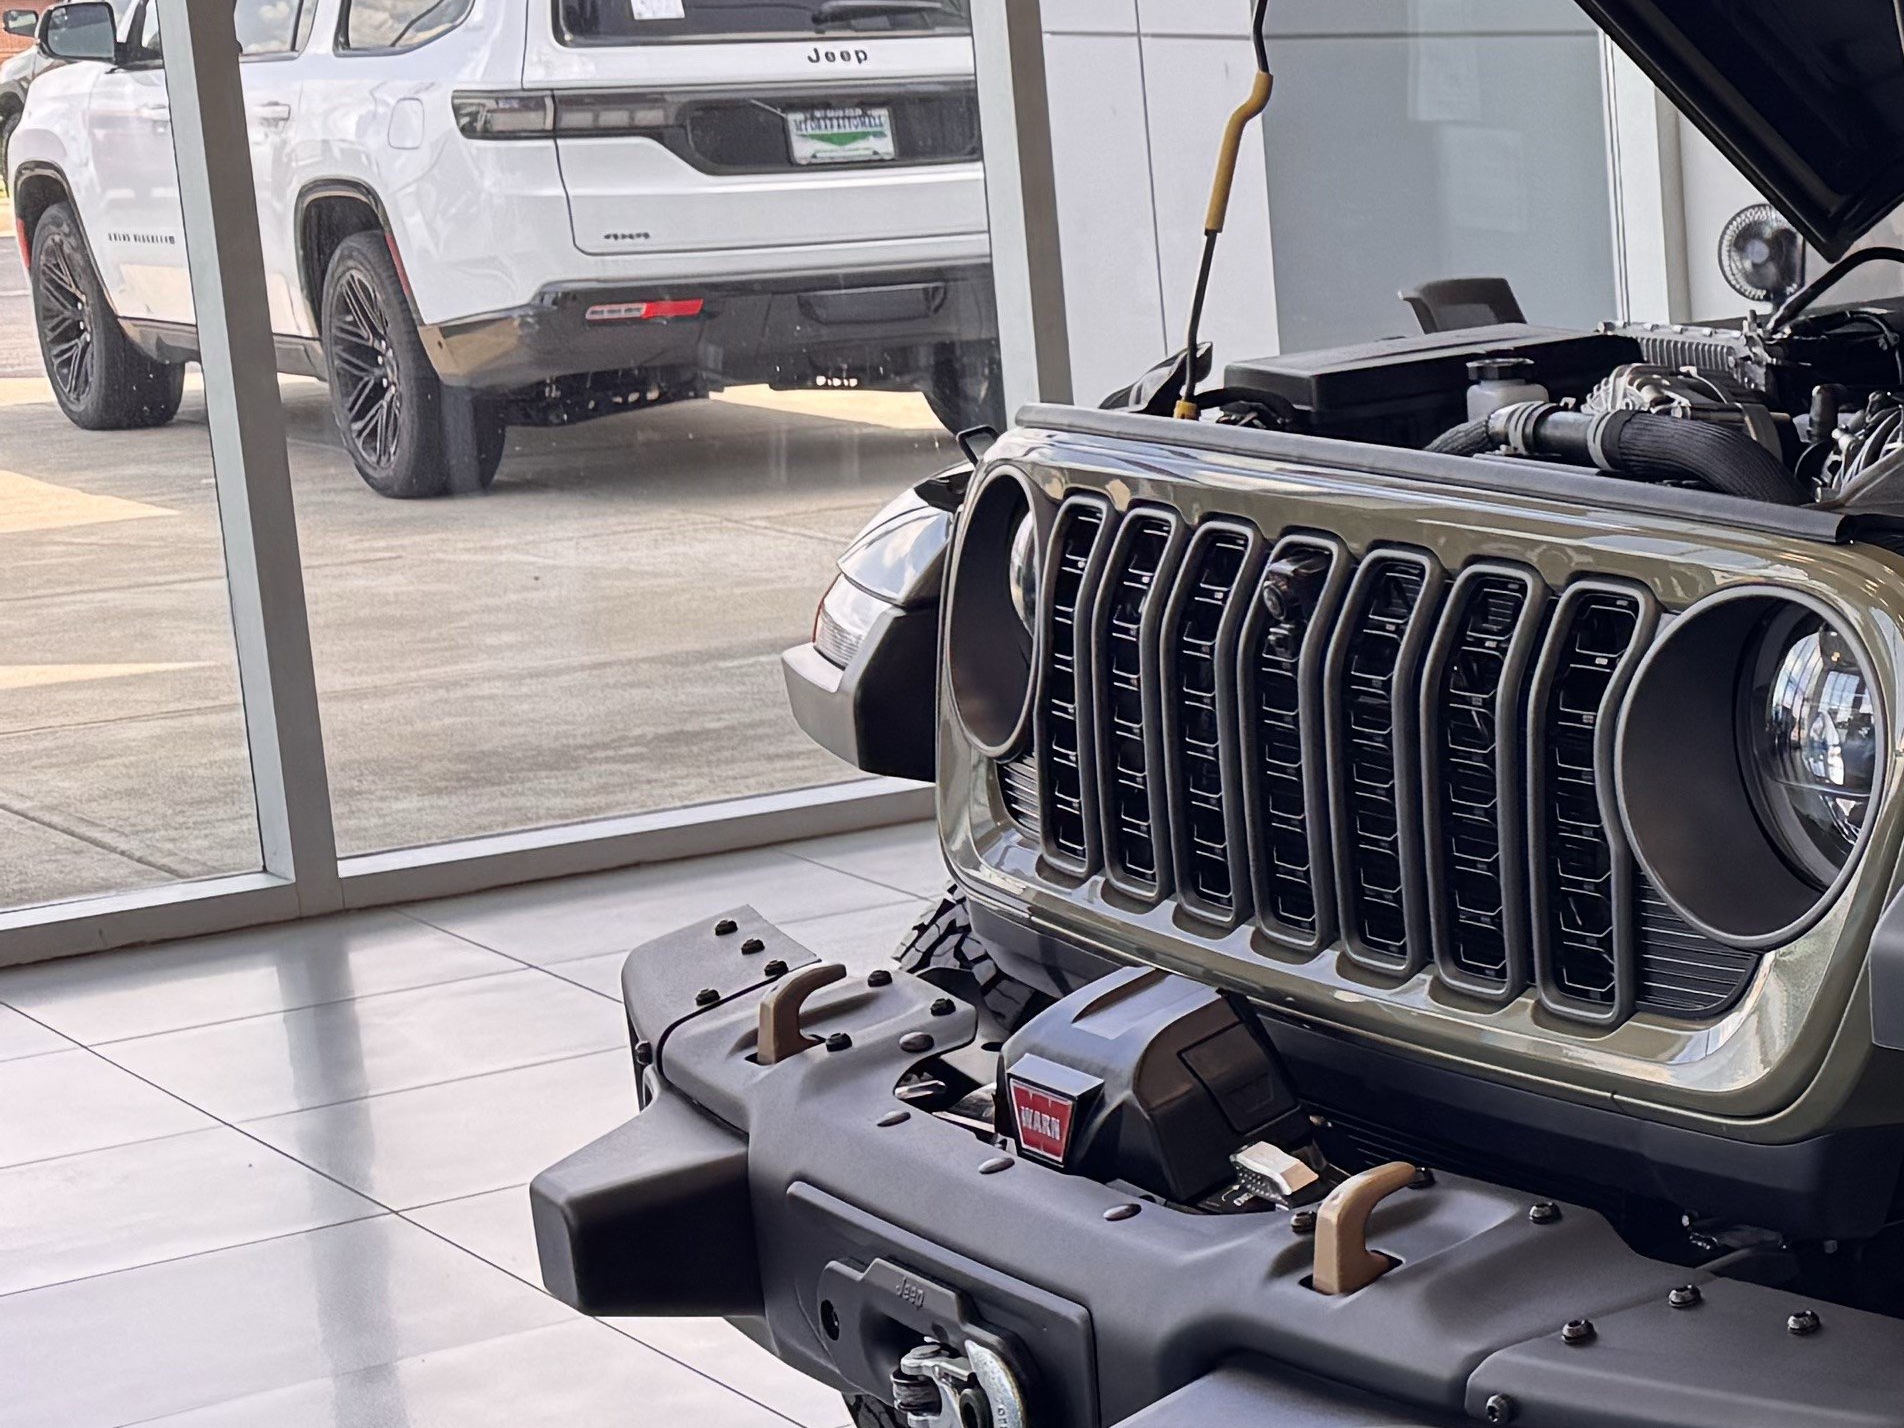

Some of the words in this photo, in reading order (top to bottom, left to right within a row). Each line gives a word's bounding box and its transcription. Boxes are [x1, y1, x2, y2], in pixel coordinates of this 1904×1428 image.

[806, 47, 868, 64] Jeep
[1020, 1105, 1061, 1142] WARN
[895, 1276, 925, 1308] Jeep
